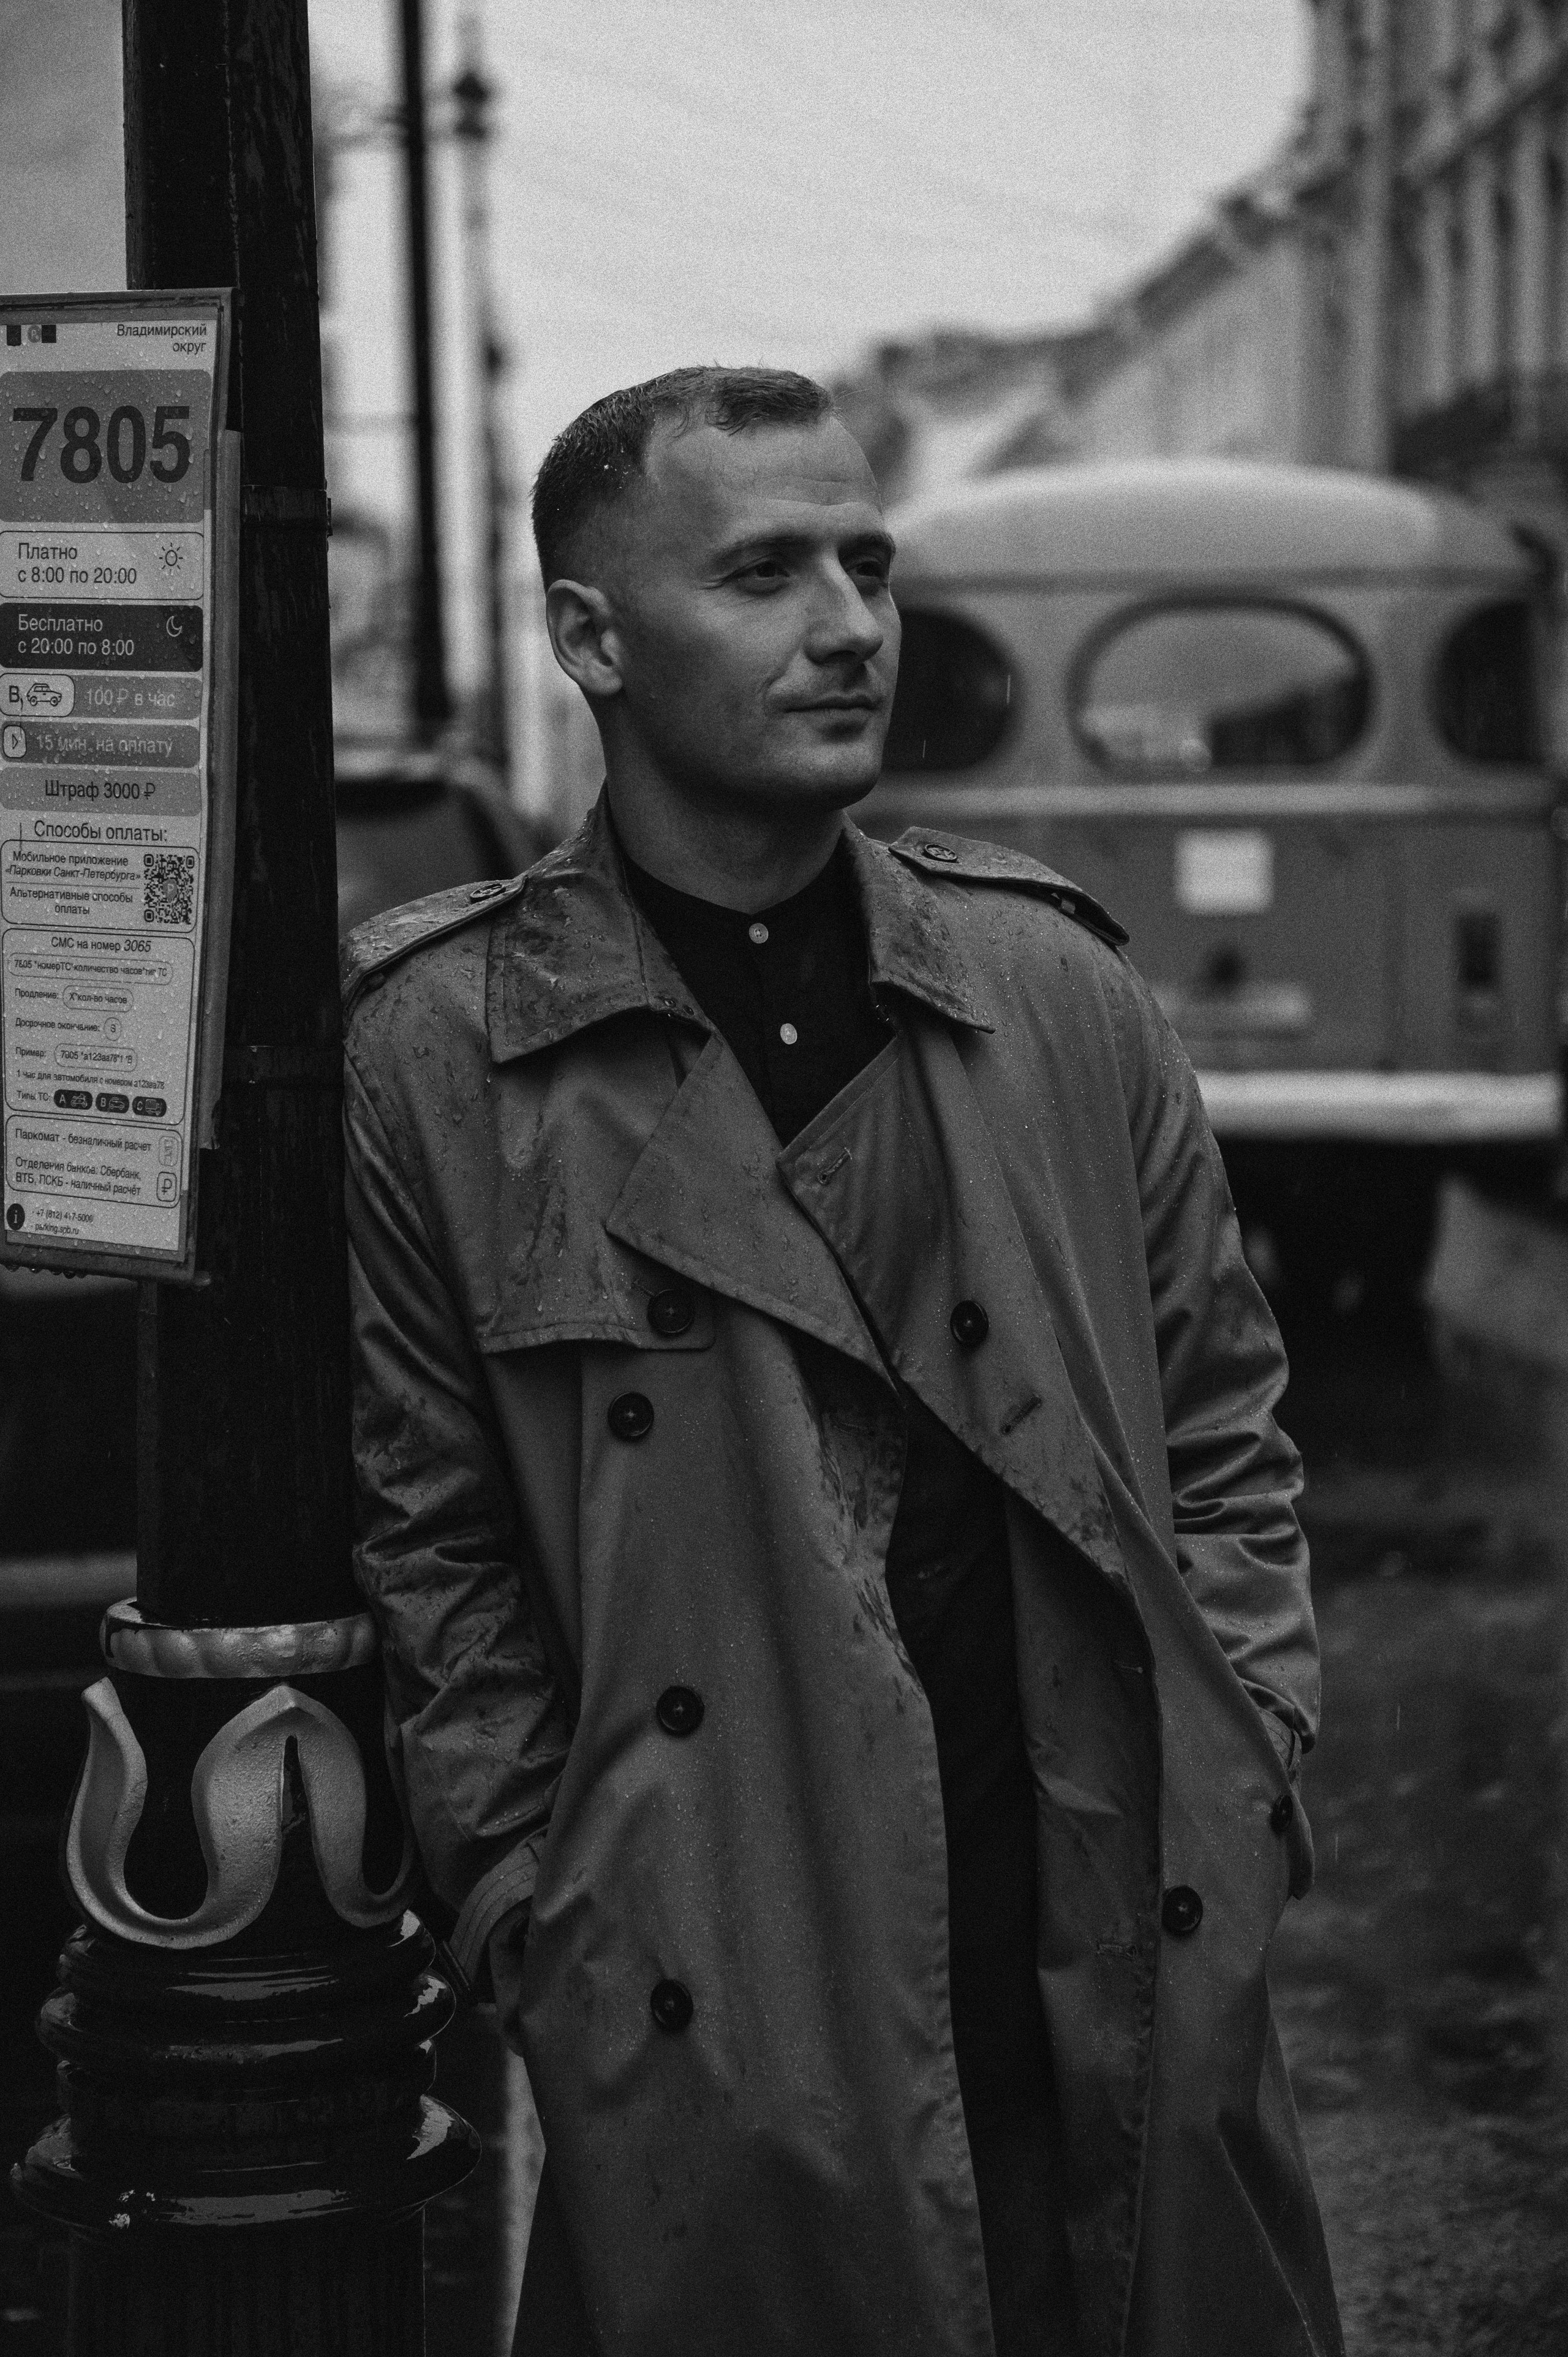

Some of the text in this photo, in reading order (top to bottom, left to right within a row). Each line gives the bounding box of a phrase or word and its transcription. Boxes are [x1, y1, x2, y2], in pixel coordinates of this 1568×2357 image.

[117, 324, 206, 338] Владимирский
[173, 341, 206, 355] округ
[13, 405, 190, 483] 7805
[18, 543, 77, 559] Платно
[18, 567, 137, 584] с 8:00 по 20:00
[18, 614, 103, 632] Бесплатно
[18, 638, 134, 655] с 20:00 по 8:00
[148, 693, 175, 707] час
[37, 734, 53, 750] 15
[96, 739, 113, 752] на
[119, 739, 173, 758] оплату
[45, 780, 99, 801] Штраф
[104, 782, 140, 799] 3000
[34, 820, 168, 842] Способы оплаты:
[13, 850, 129, 867] Мобильное приложение
[6, 864, 140, 883] «Парковки Санкт-Петербурга»
[10, 886, 133, 903] Альтернативные способы
[55, 905, 90, 915] оплаты
[51, 937, 152, 954] СМС на номер 3065
[15, 988, 59, 999] Продление:
[105, 995, 127, 1004] часов
[15, 1017, 100, 1032] Досрочное окончание:
[15, 1046, 47, 1058] Пример:
[37, 1073, 51, 1082] для
[53, 1073, 98, 1085] автомобиля
[15, 1128, 60, 1143] Паркомат
[69, 1133, 122, 1148] безналичный
[15, 1156, 141, 1180] Отделения банков: Сбербанк,
[16, 1172, 36, 1185] ВТБ,
[39, 1174, 63, 1186] ПСКБ
[71, 1180, 111, 1193] наличный
